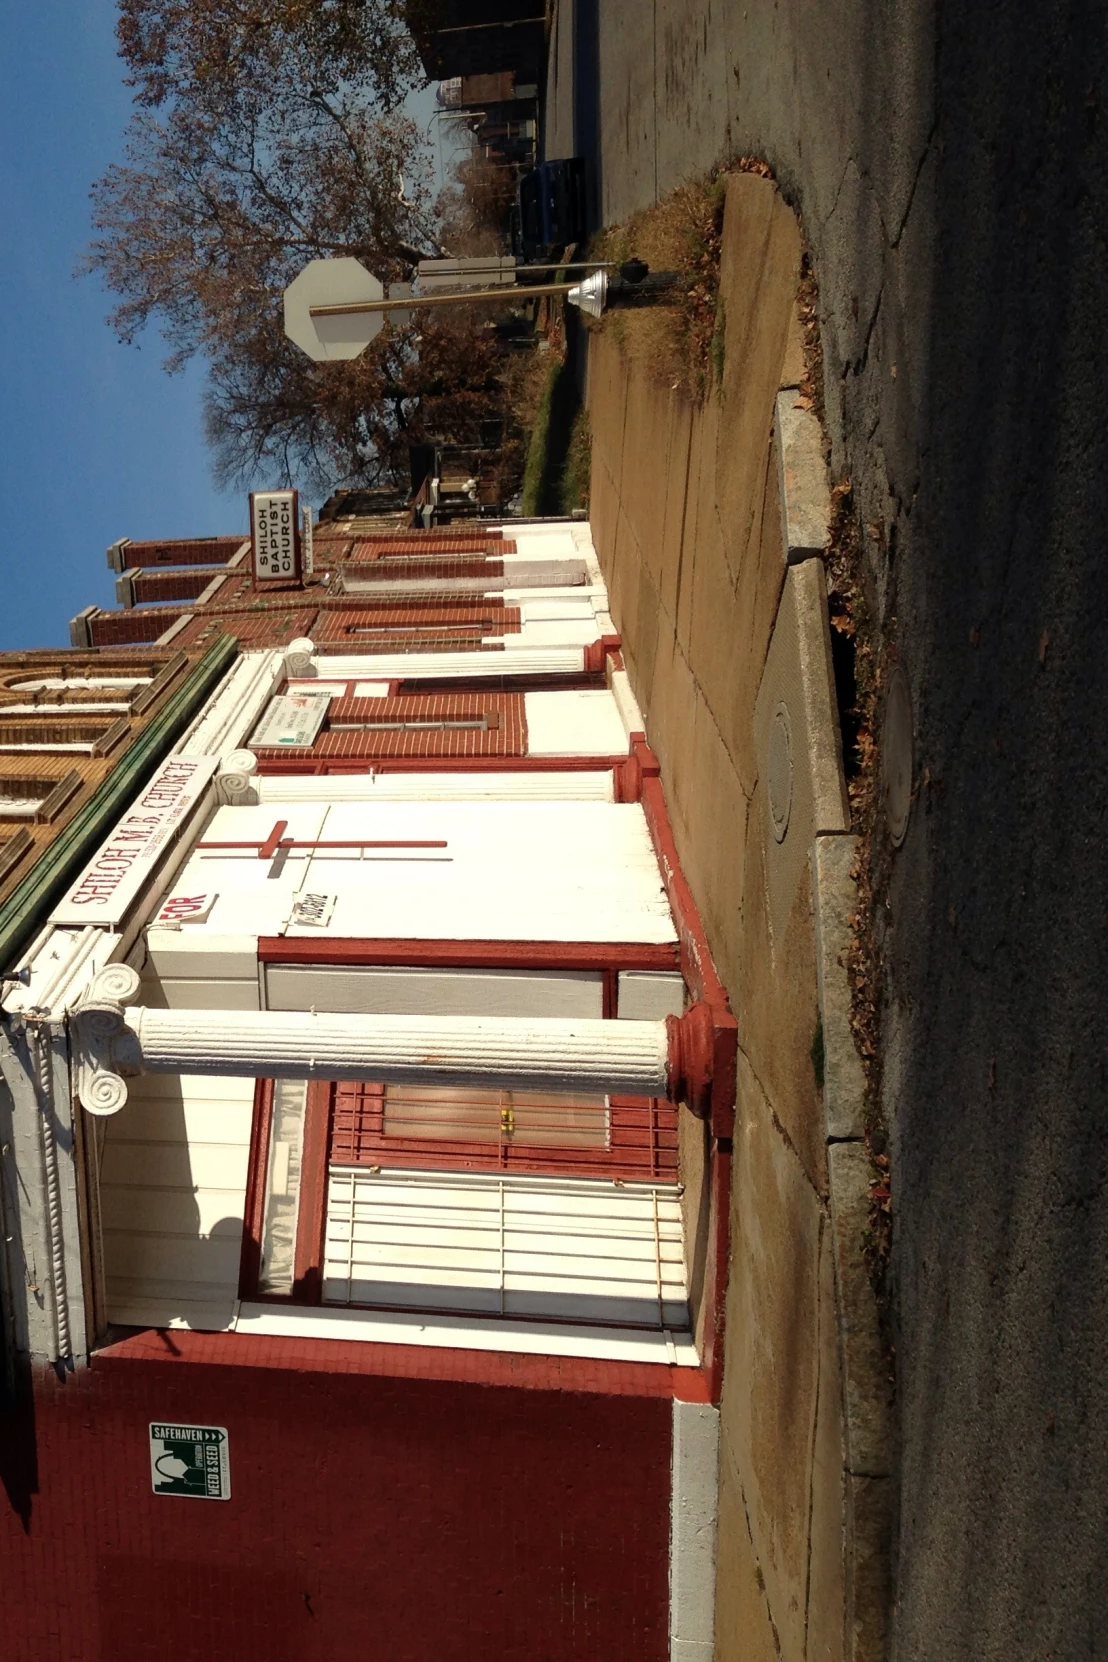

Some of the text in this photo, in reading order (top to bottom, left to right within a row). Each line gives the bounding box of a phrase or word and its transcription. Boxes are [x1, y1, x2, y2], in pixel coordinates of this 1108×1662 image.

[259, 509, 268, 566] SHILOH
[269, 500, 280, 573] BAPTIST
[281, 502, 291, 571] CHURCH
[71, 846, 140, 905] SHILOH
[141, 760, 198, 809] CHURCH
[159, 894, 207, 920] FOR
[154, 1426, 203, 1441] SAFEHAVEN
[195, 1445, 203, 1468] OPERATION
[206, 1445, 219, 1466] SEED
[207, 1474, 220, 1495] WEED
